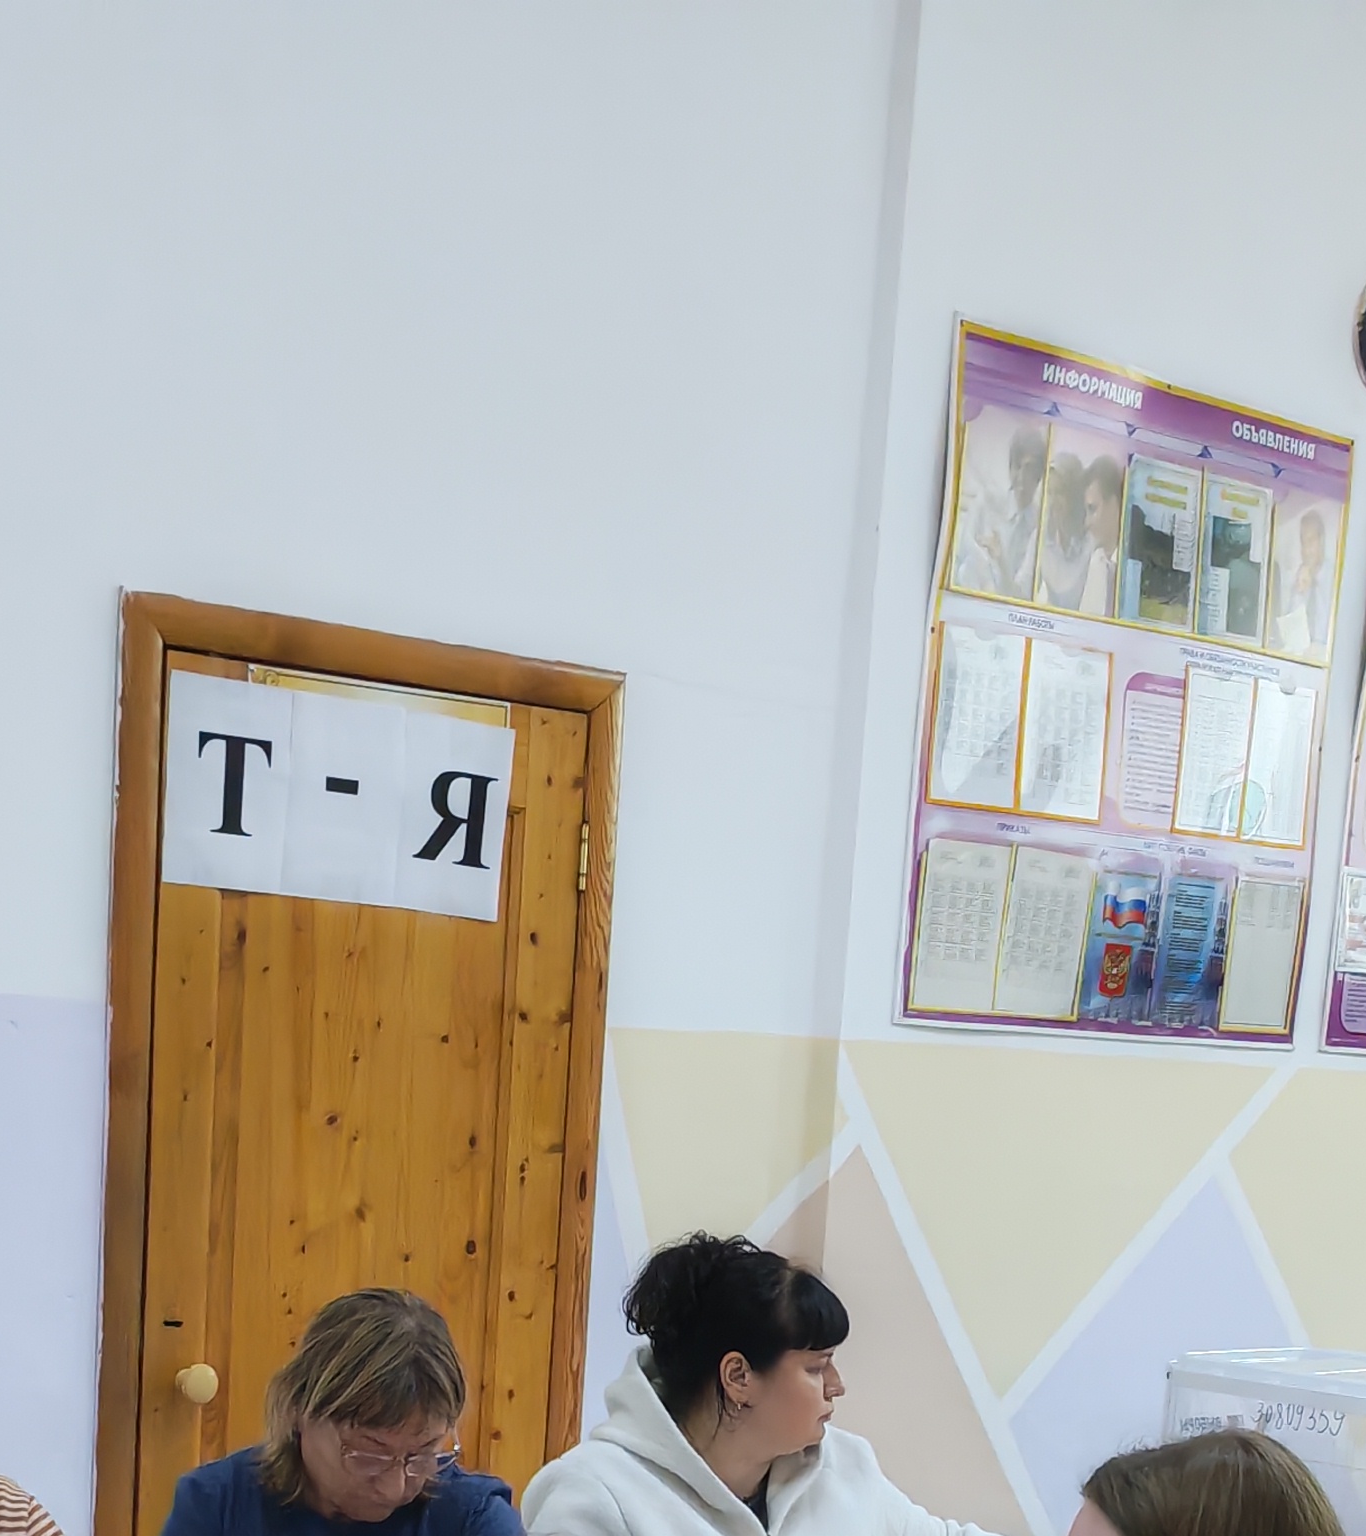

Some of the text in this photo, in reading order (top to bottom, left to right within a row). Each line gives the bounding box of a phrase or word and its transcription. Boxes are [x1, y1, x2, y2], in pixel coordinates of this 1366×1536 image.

[1042, 362, 1144, 410] ИНФОРМАЦИЯ
[1231, 419, 1317, 461] ОБЪЯВЛЕНИЯ
[198, 730, 273, 838] Т
[411, 770, 500, 870] Я
